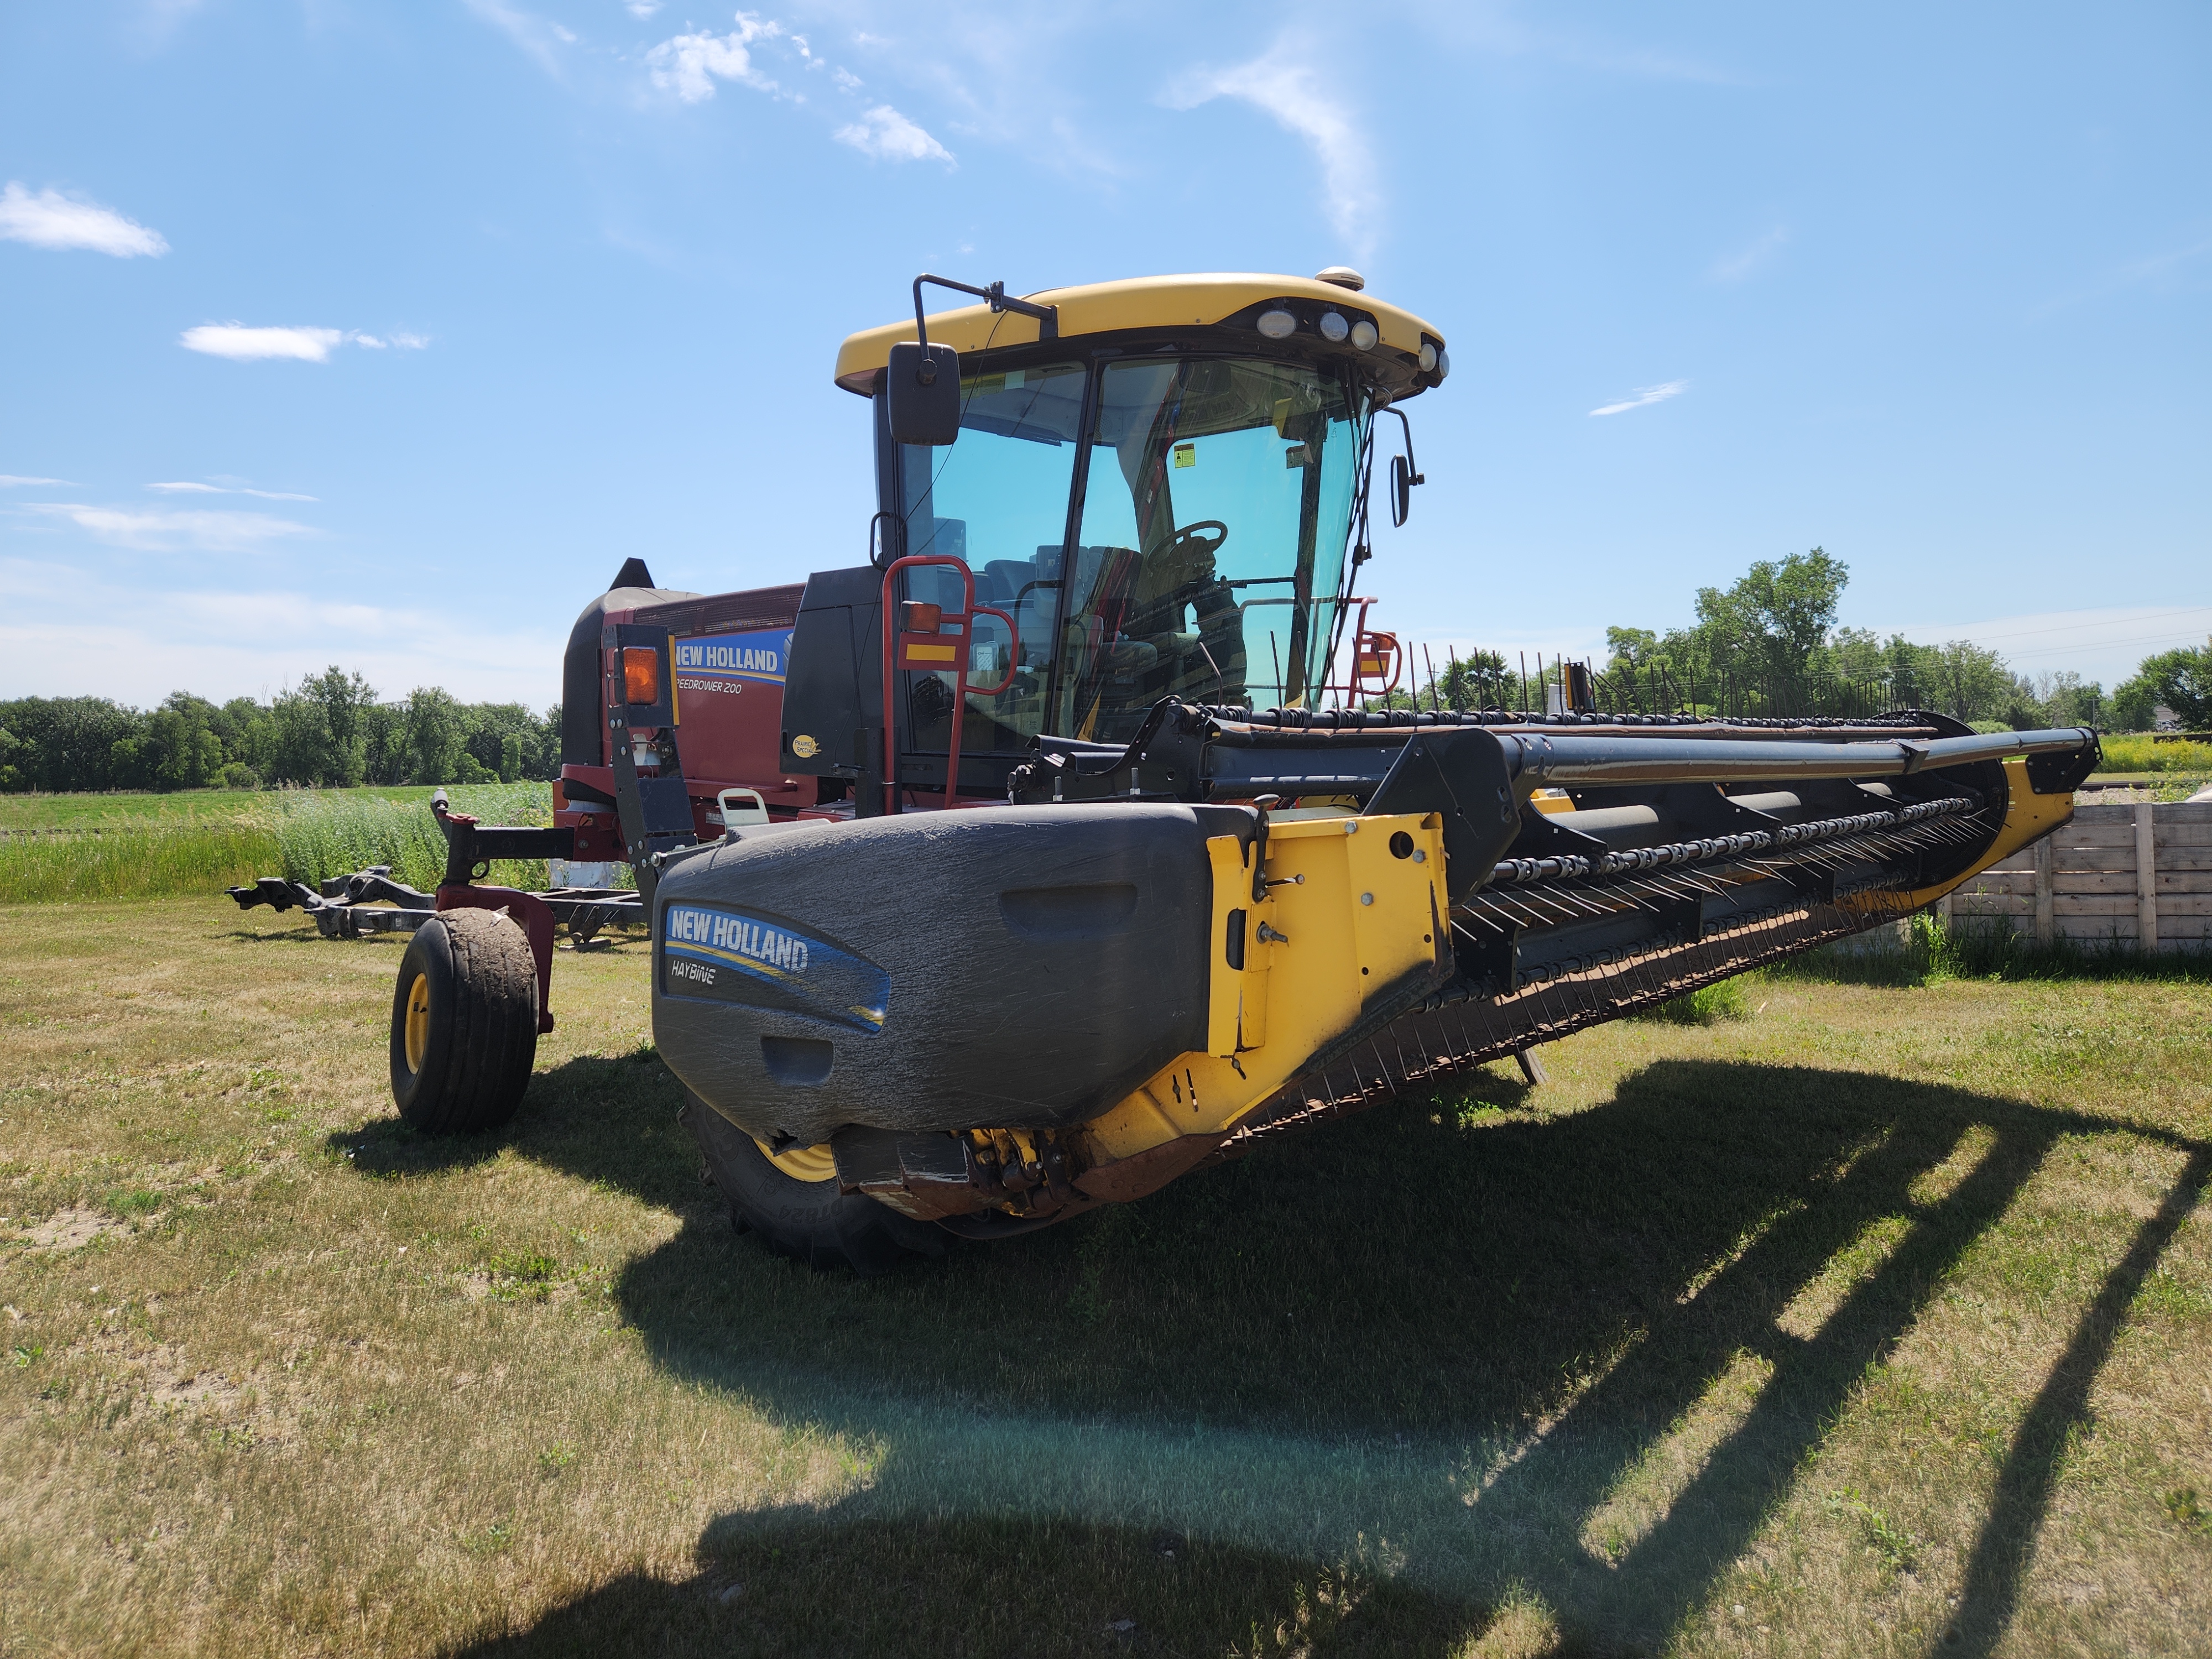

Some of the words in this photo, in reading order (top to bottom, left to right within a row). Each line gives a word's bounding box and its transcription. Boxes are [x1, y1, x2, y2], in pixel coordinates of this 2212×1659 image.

[706, 646, 778, 672] HOLLAND
[677, 679, 723, 692] EEDROWER
[723, 682, 742, 694] 200
[672, 910, 712, 943] NEW
[713, 916, 808, 973] HOLLAND
[671, 960, 716, 985] HAYBINE
[778, 1197, 843, 1224] DT824
